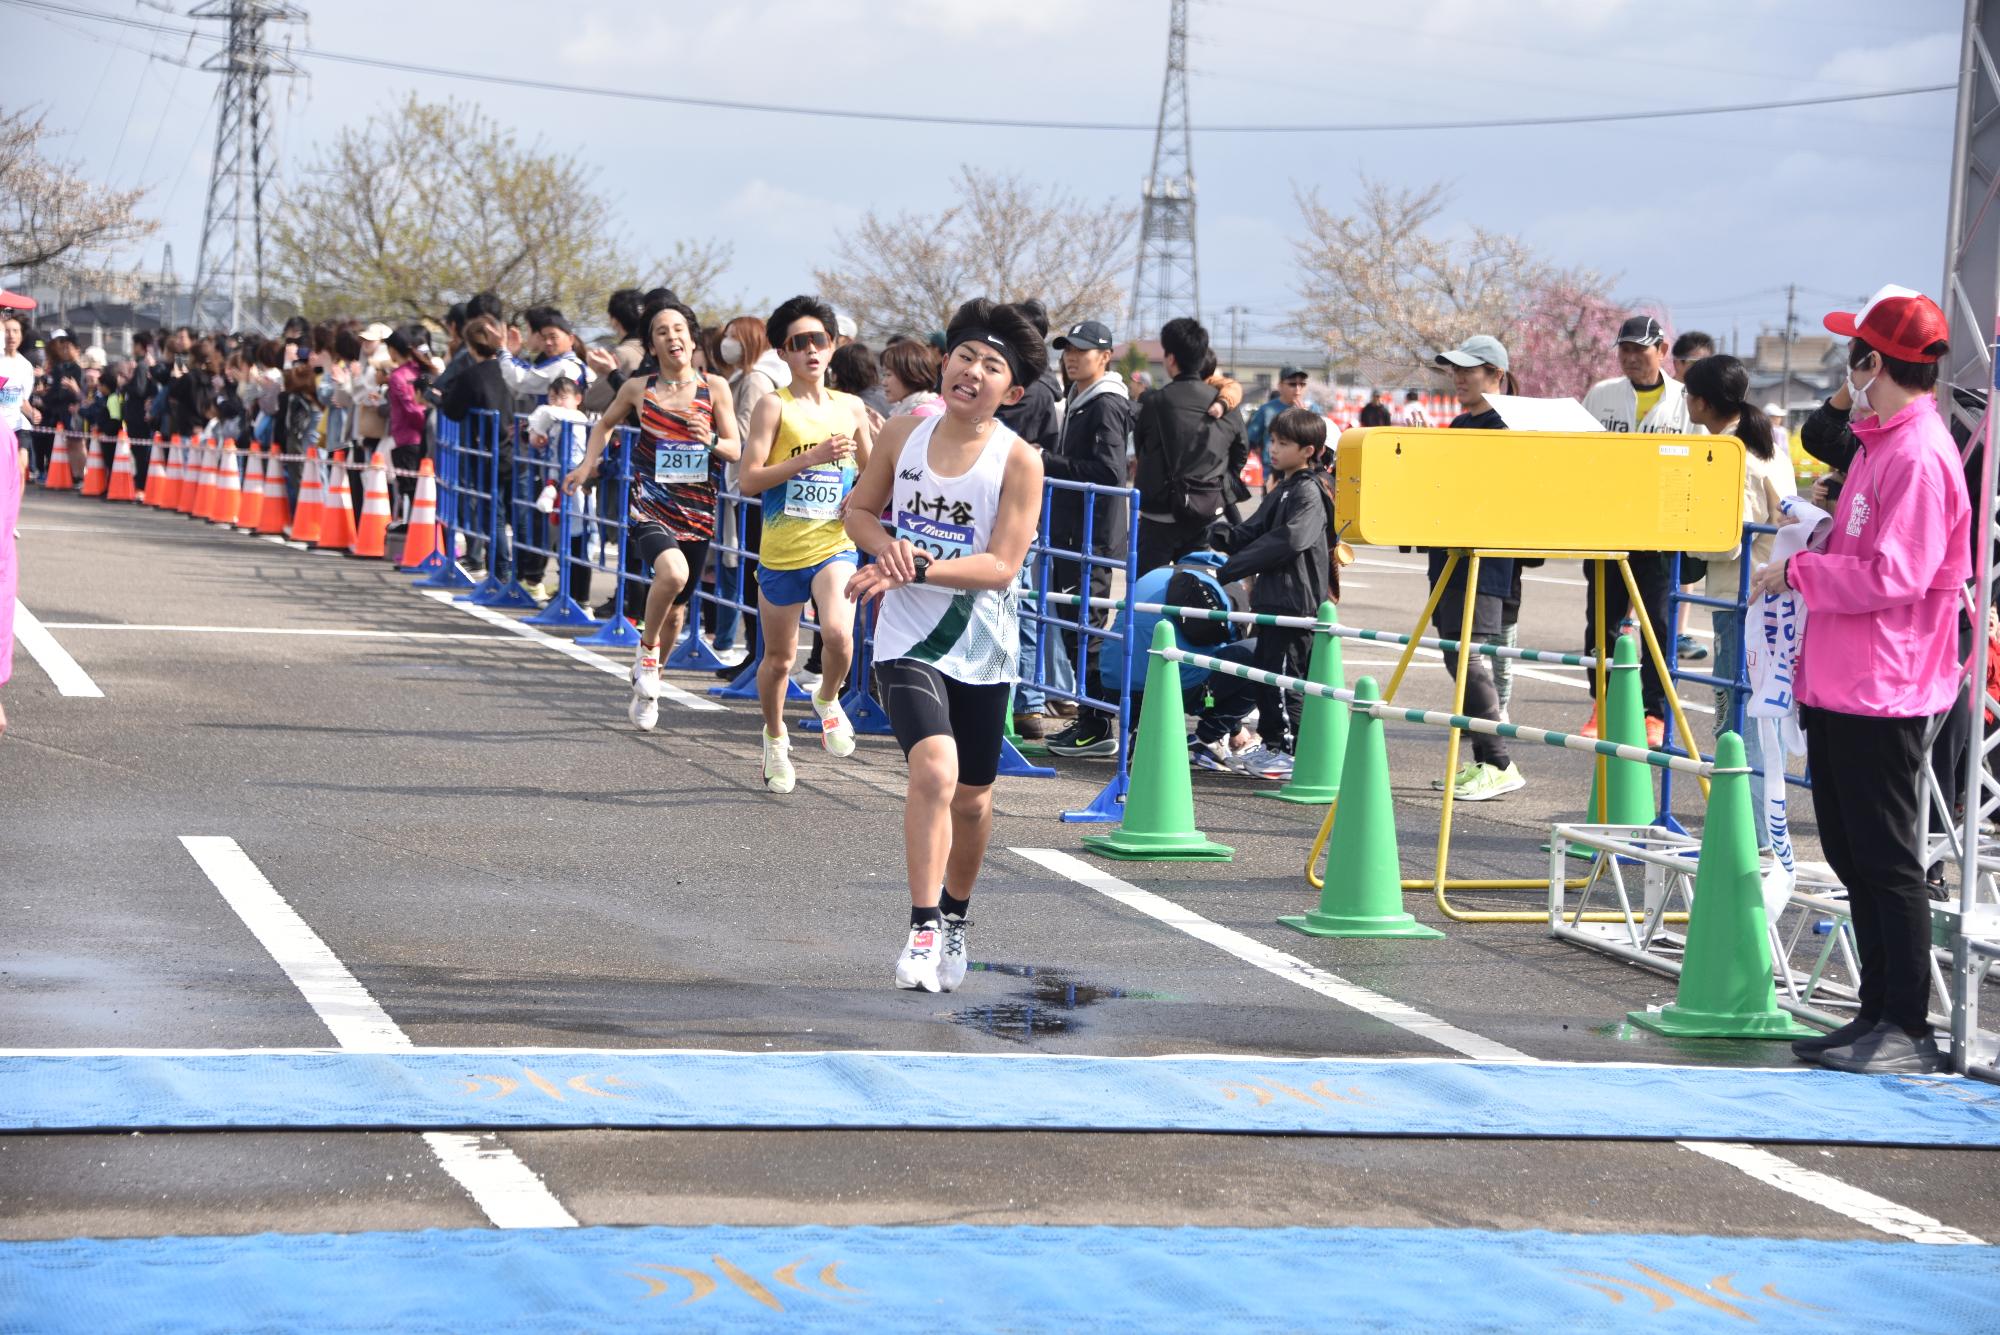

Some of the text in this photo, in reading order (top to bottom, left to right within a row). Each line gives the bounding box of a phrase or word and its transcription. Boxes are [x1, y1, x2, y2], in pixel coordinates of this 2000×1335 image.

[661, 453, 704, 469] 2817
[792, 484, 838, 503] 2805
[907, 491, 975, 525] 小千谷
